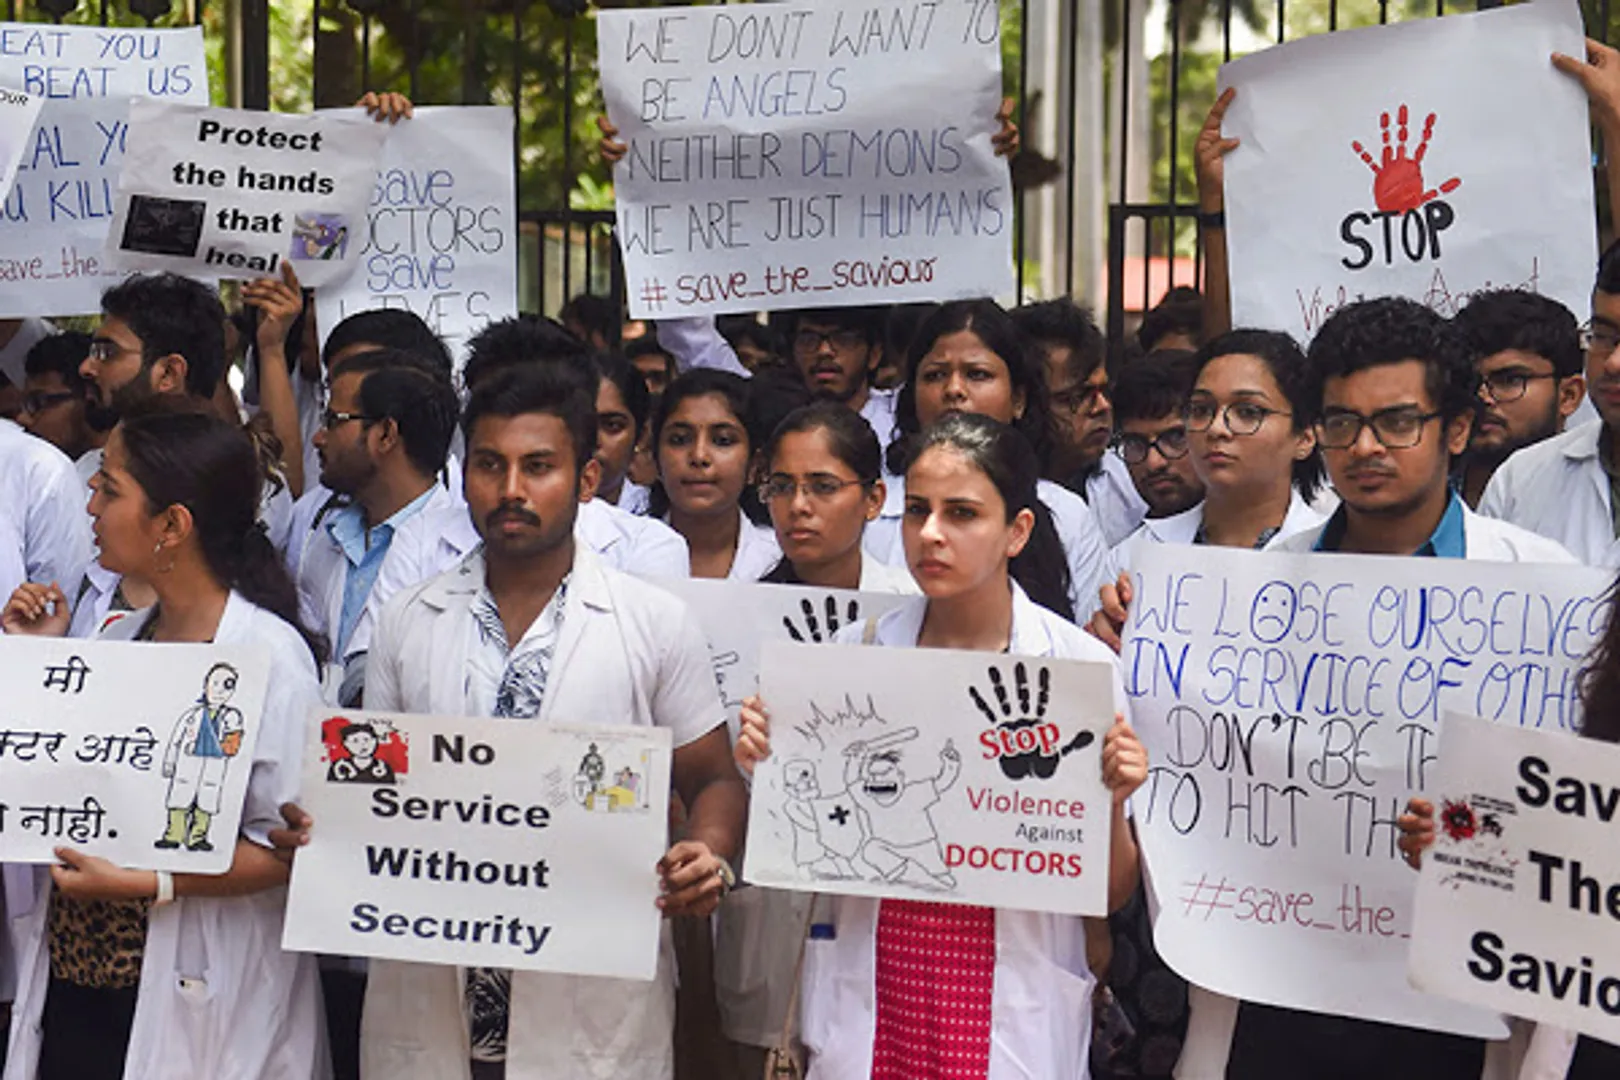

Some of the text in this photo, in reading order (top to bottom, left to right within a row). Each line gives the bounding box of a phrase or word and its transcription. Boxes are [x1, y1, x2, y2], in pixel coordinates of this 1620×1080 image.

[95, 33, 161, 60] YOU
[627, 16, 687, 64] WE
[707, 11, 814, 64] DONT
[829, 3, 938, 57] WANT
[24, 63, 193, 99] BEAT US
[640, 67, 849, 123] BE ANGELS
[18, 125, 80, 170] AL
[197, 119, 323, 152] Protect
[628, 126, 963, 184] NEITHER DEMONS
[172, 162, 335, 196] the hands
[216, 207, 284, 234] that
[623, 187, 1004, 256] WE ARE JUST HUMANS
[1340, 200, 1455, 270] STOP
[204, 247, 280, 274] heal
[367, 254, 455, 292] save
[1135, 572, 1204, 635] WE
[43, 655, 92, 694] मी
[1123, 636, 1192, 701] IN
[1201, 644, 1392, 720] SERVICE
[1397, 655, 1473, 722] OF
[75, 726, 159, 771] आहे
[432, 734, 496, 766] No
[978, 721, 1061, 760] Stop
[1166, 704, 1308, 778] DON'T
[1307, 717, 1379, 790] BE
[371, 788, 552, 829] Service
[966, 785, 1085, 820] Violence
[1147, 766, 1202, 836] TO
[1225, 777, 1311, 849] HIT
[1015, 822, 1084, 844] Against
[365, 845, 550, 889] Without
[944, 843, 1083, 878] DOCTORS
[350, 902, 552, 955] Security
